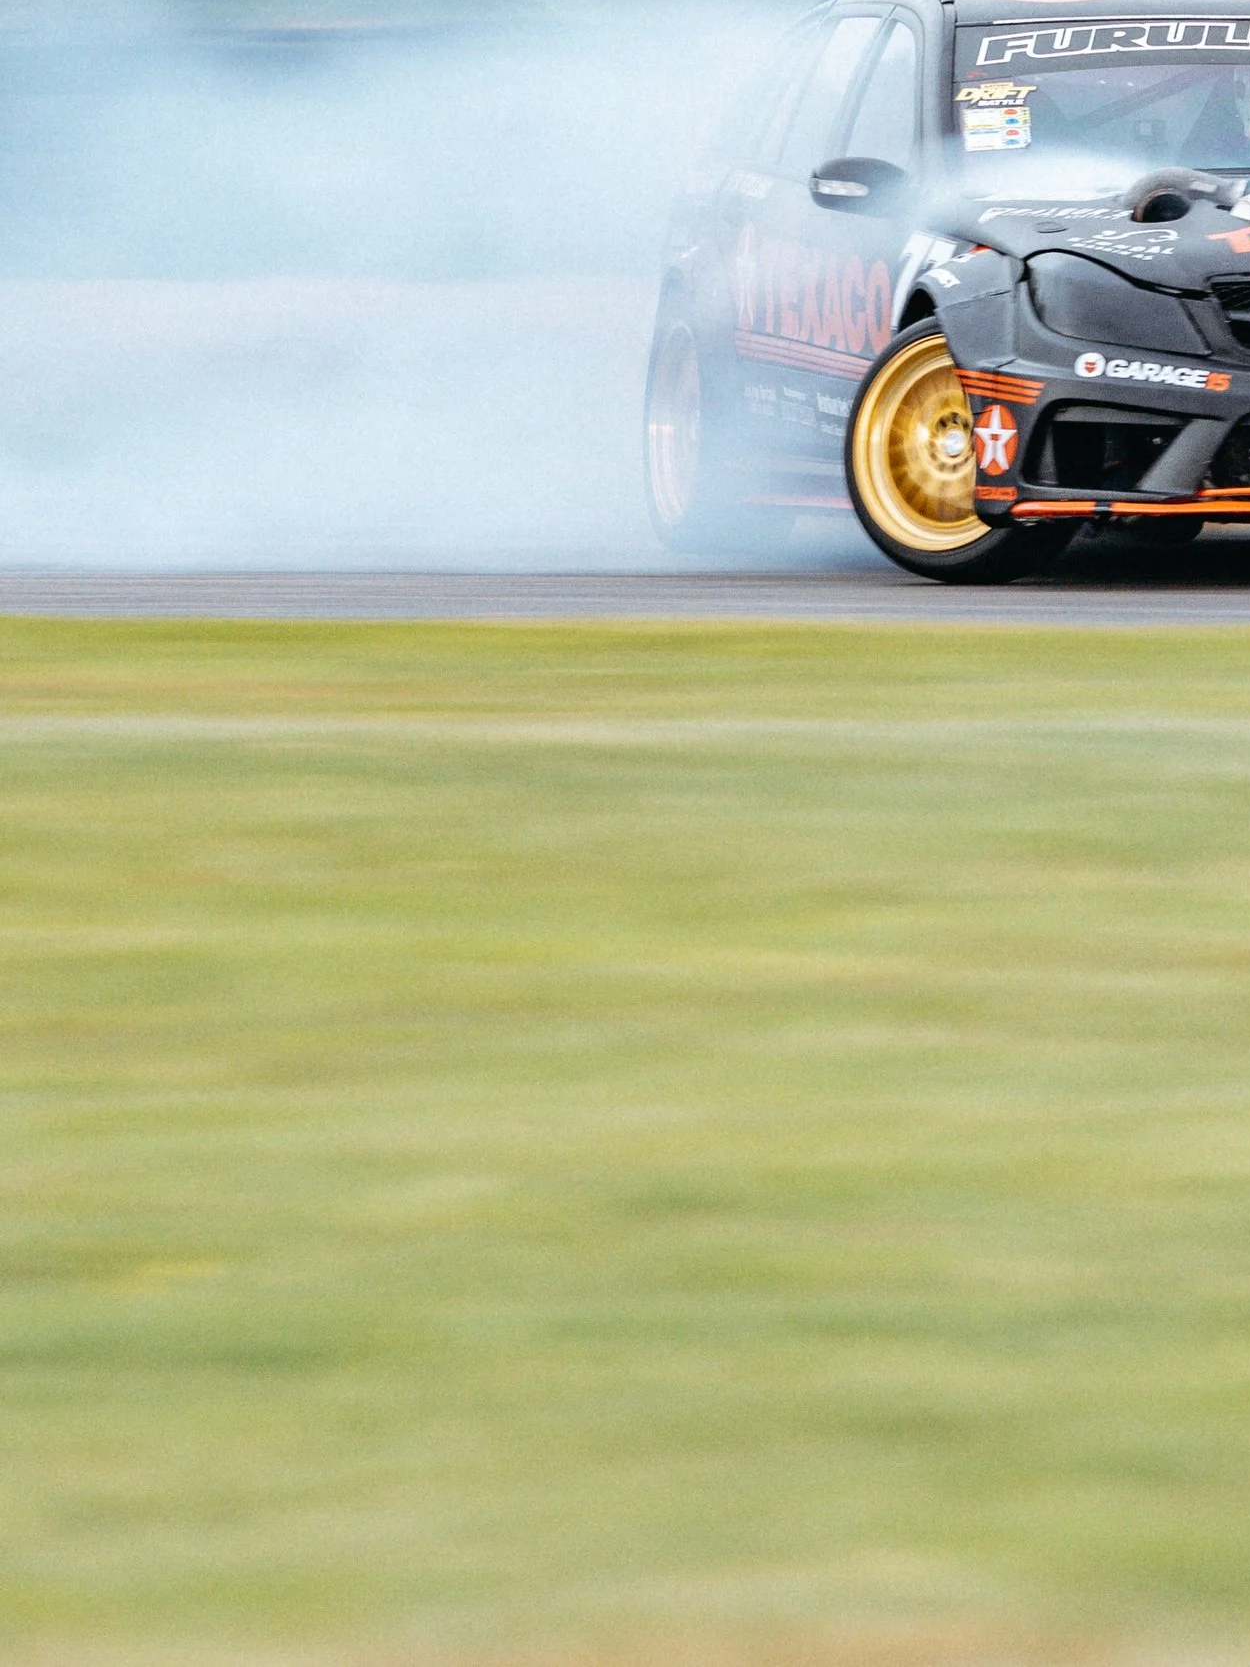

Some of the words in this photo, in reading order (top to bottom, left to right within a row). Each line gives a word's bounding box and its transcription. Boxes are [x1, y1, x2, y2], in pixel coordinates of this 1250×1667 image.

[955, 85, 1038, 105] DRIFT
[977, 98, 1026, 107] BATTLE
[758, 238, 893, 357] TEXACO
